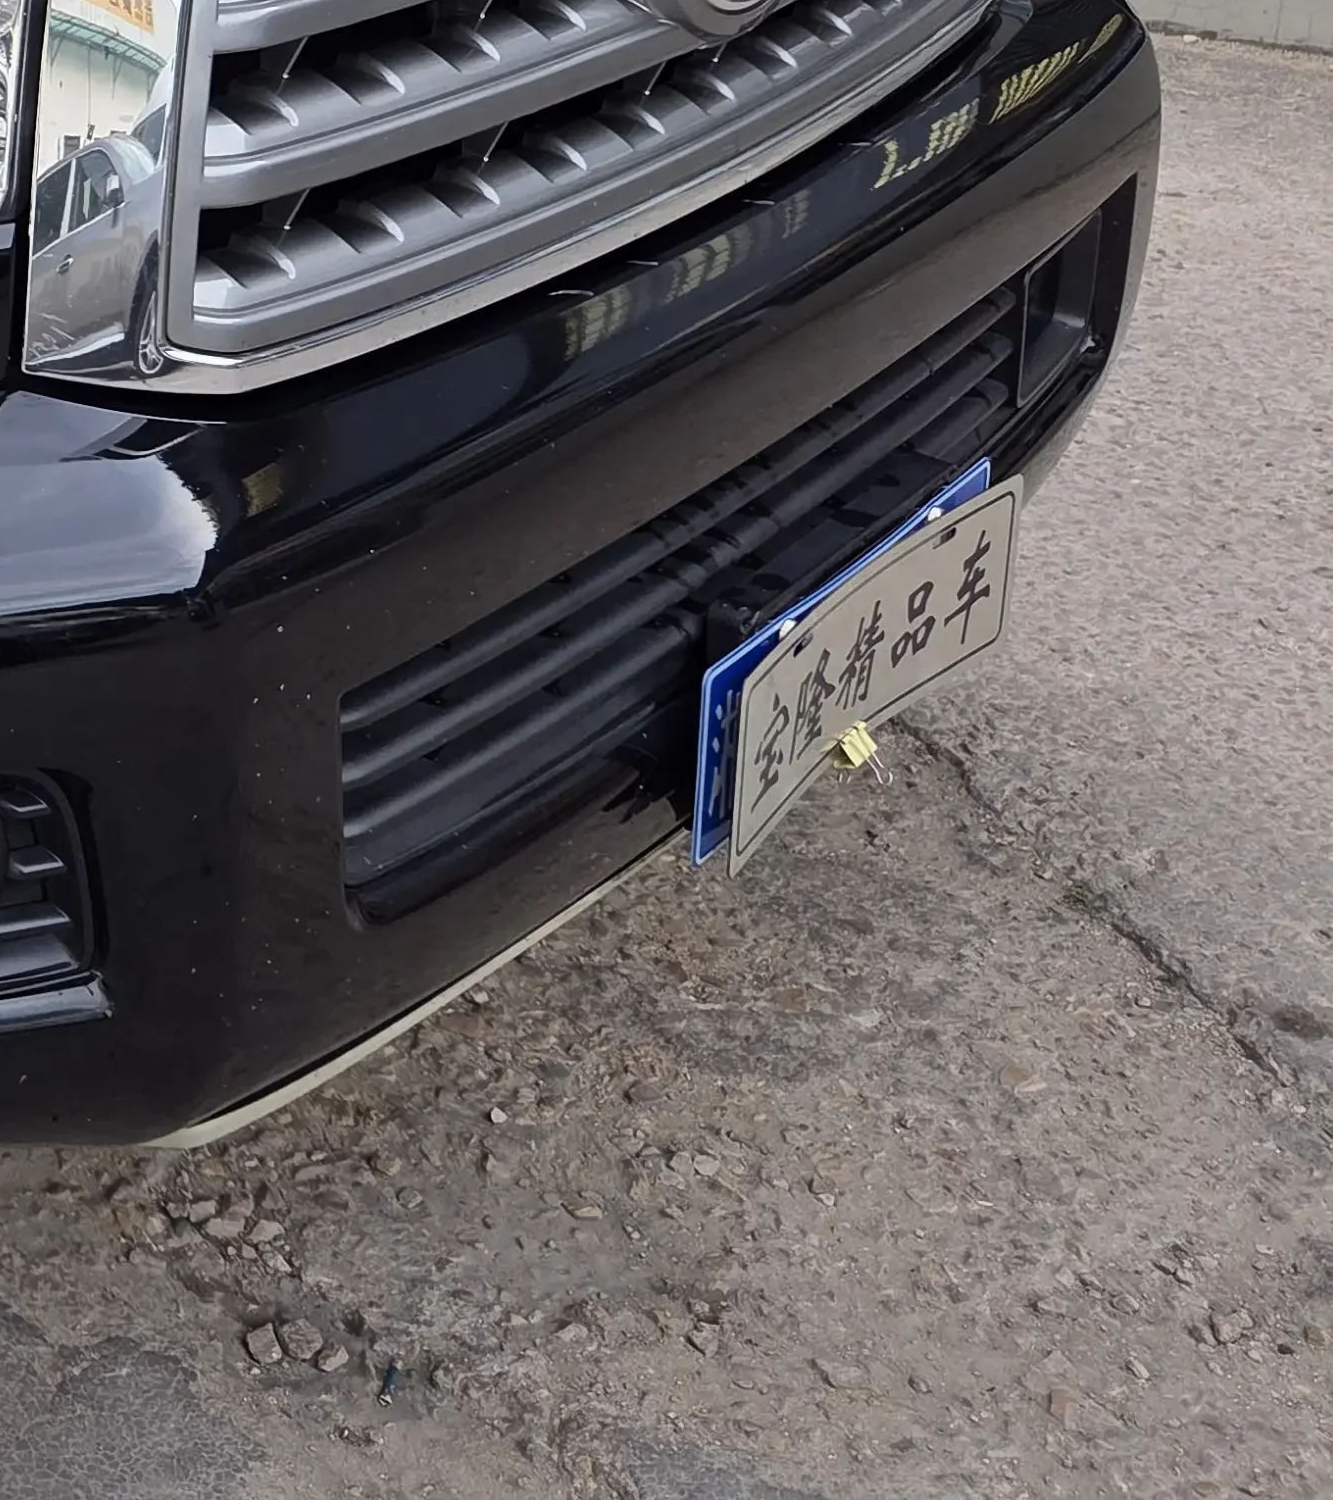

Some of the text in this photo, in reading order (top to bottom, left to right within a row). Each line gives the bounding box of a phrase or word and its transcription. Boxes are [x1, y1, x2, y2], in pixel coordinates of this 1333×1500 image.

[751, 529, 991, 813] 宝隆精品车
